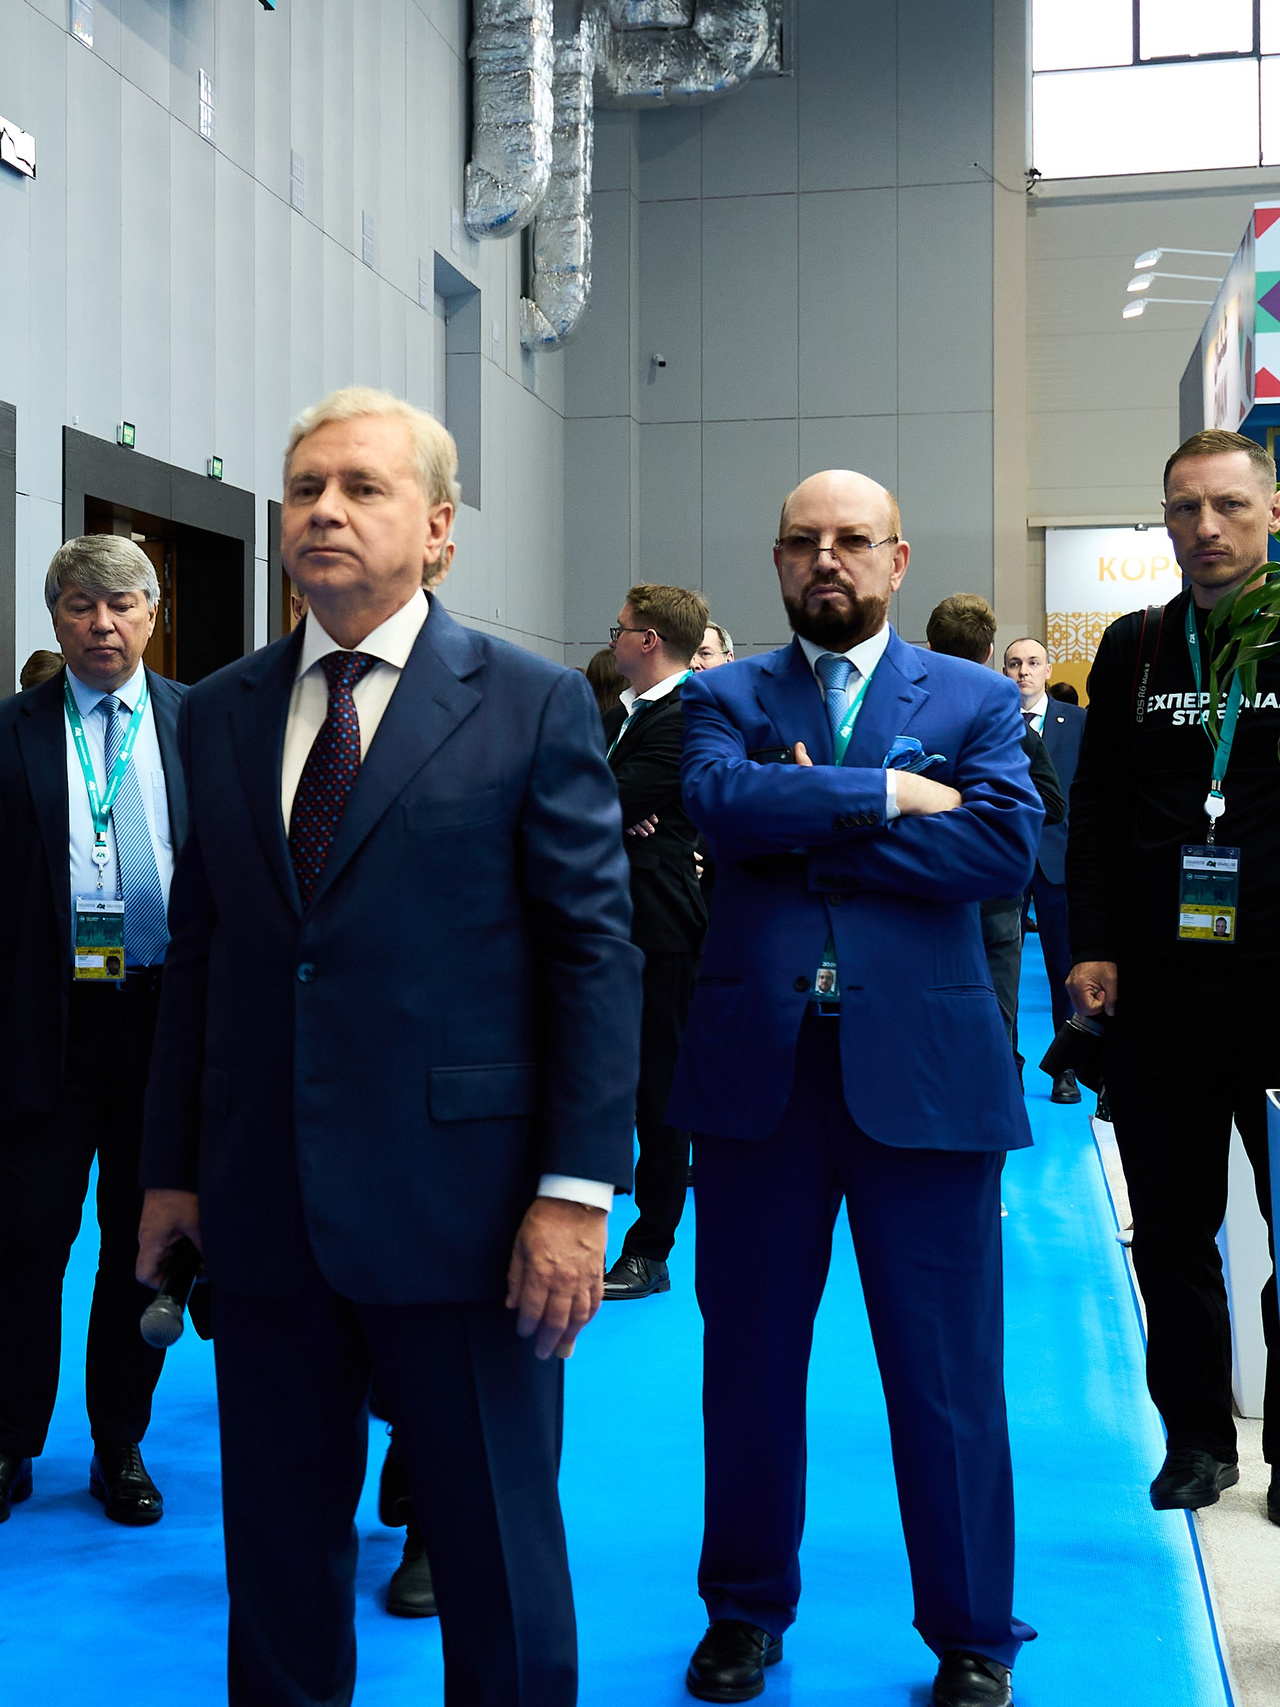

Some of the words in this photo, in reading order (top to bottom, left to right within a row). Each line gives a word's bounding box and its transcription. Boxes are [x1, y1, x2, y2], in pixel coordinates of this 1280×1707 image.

[1142, 668, 1150, 685] Mark
[1138, 685, 1147, 698] R6
[1136, 699, 1145, 723] EOS
[1172, 709, 1242, 726] STAF
